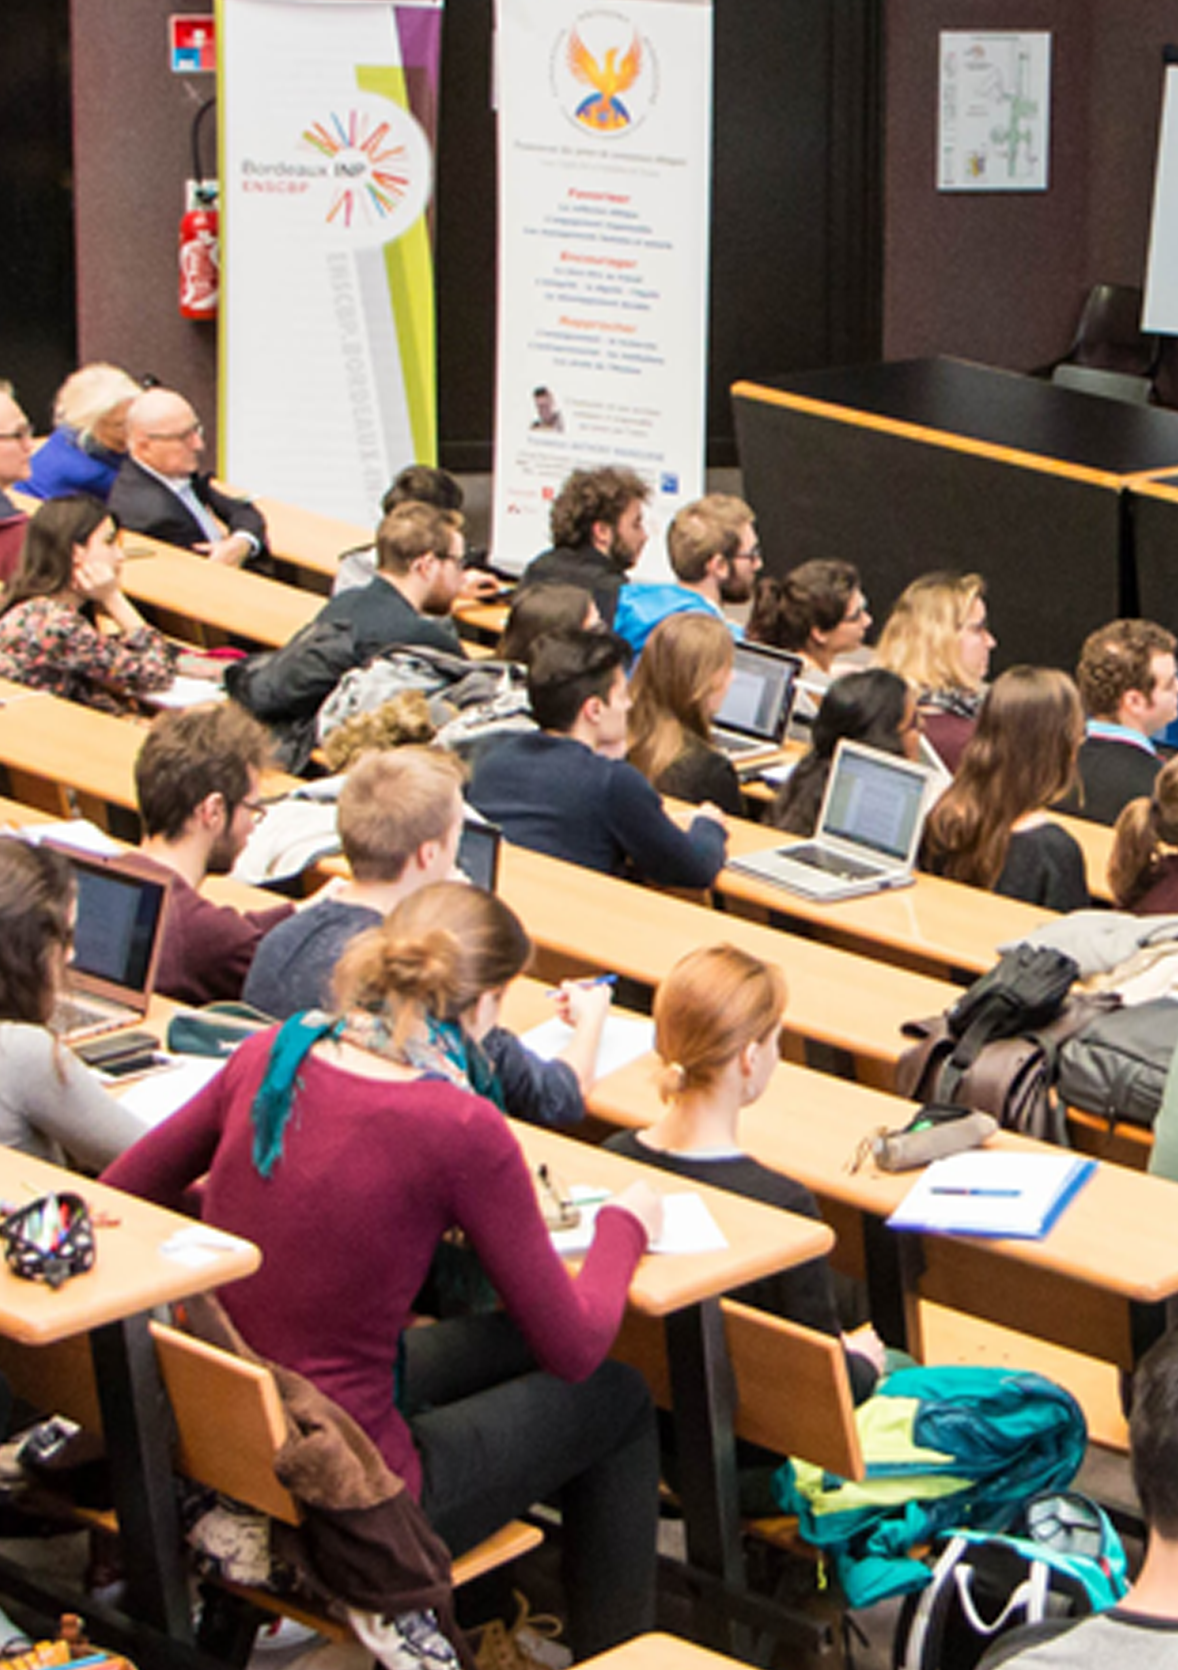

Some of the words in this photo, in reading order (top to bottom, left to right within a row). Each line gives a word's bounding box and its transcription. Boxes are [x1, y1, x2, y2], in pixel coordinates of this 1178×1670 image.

[241, 159, 328, 178] Bordeaux
[333, 163, 368, 178] INP
[241, 180, 310, 194] ENSCBP
